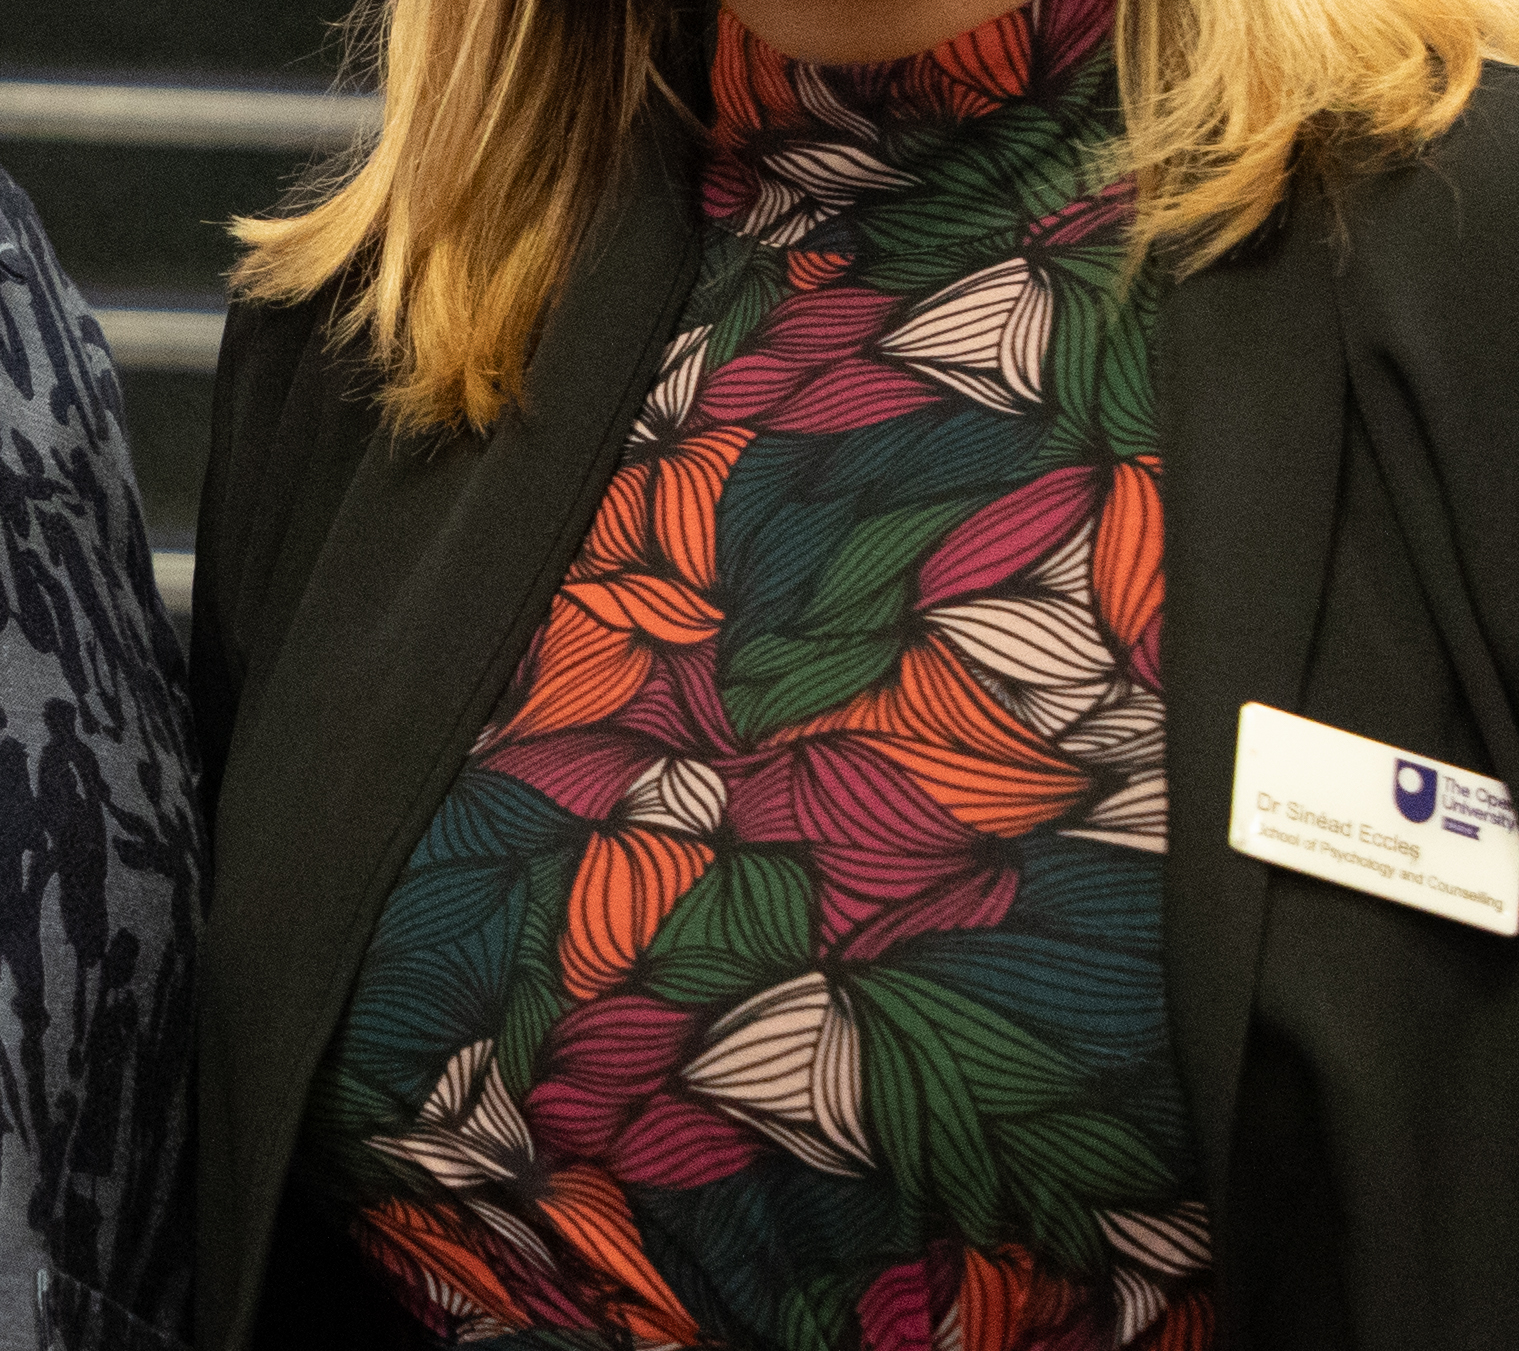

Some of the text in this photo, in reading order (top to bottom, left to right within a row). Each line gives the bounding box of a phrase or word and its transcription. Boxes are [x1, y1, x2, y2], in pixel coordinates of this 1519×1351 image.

[1257, 791, 1280, 813] Dr
[1443, 776, 1471, 798] The
[1442, 795, 1516, 834] University
[1319, 840, 1397, 880] Psychology
[1399, 869, 1423, 884] and
[1427, 875, 1503, 913] Counselling
